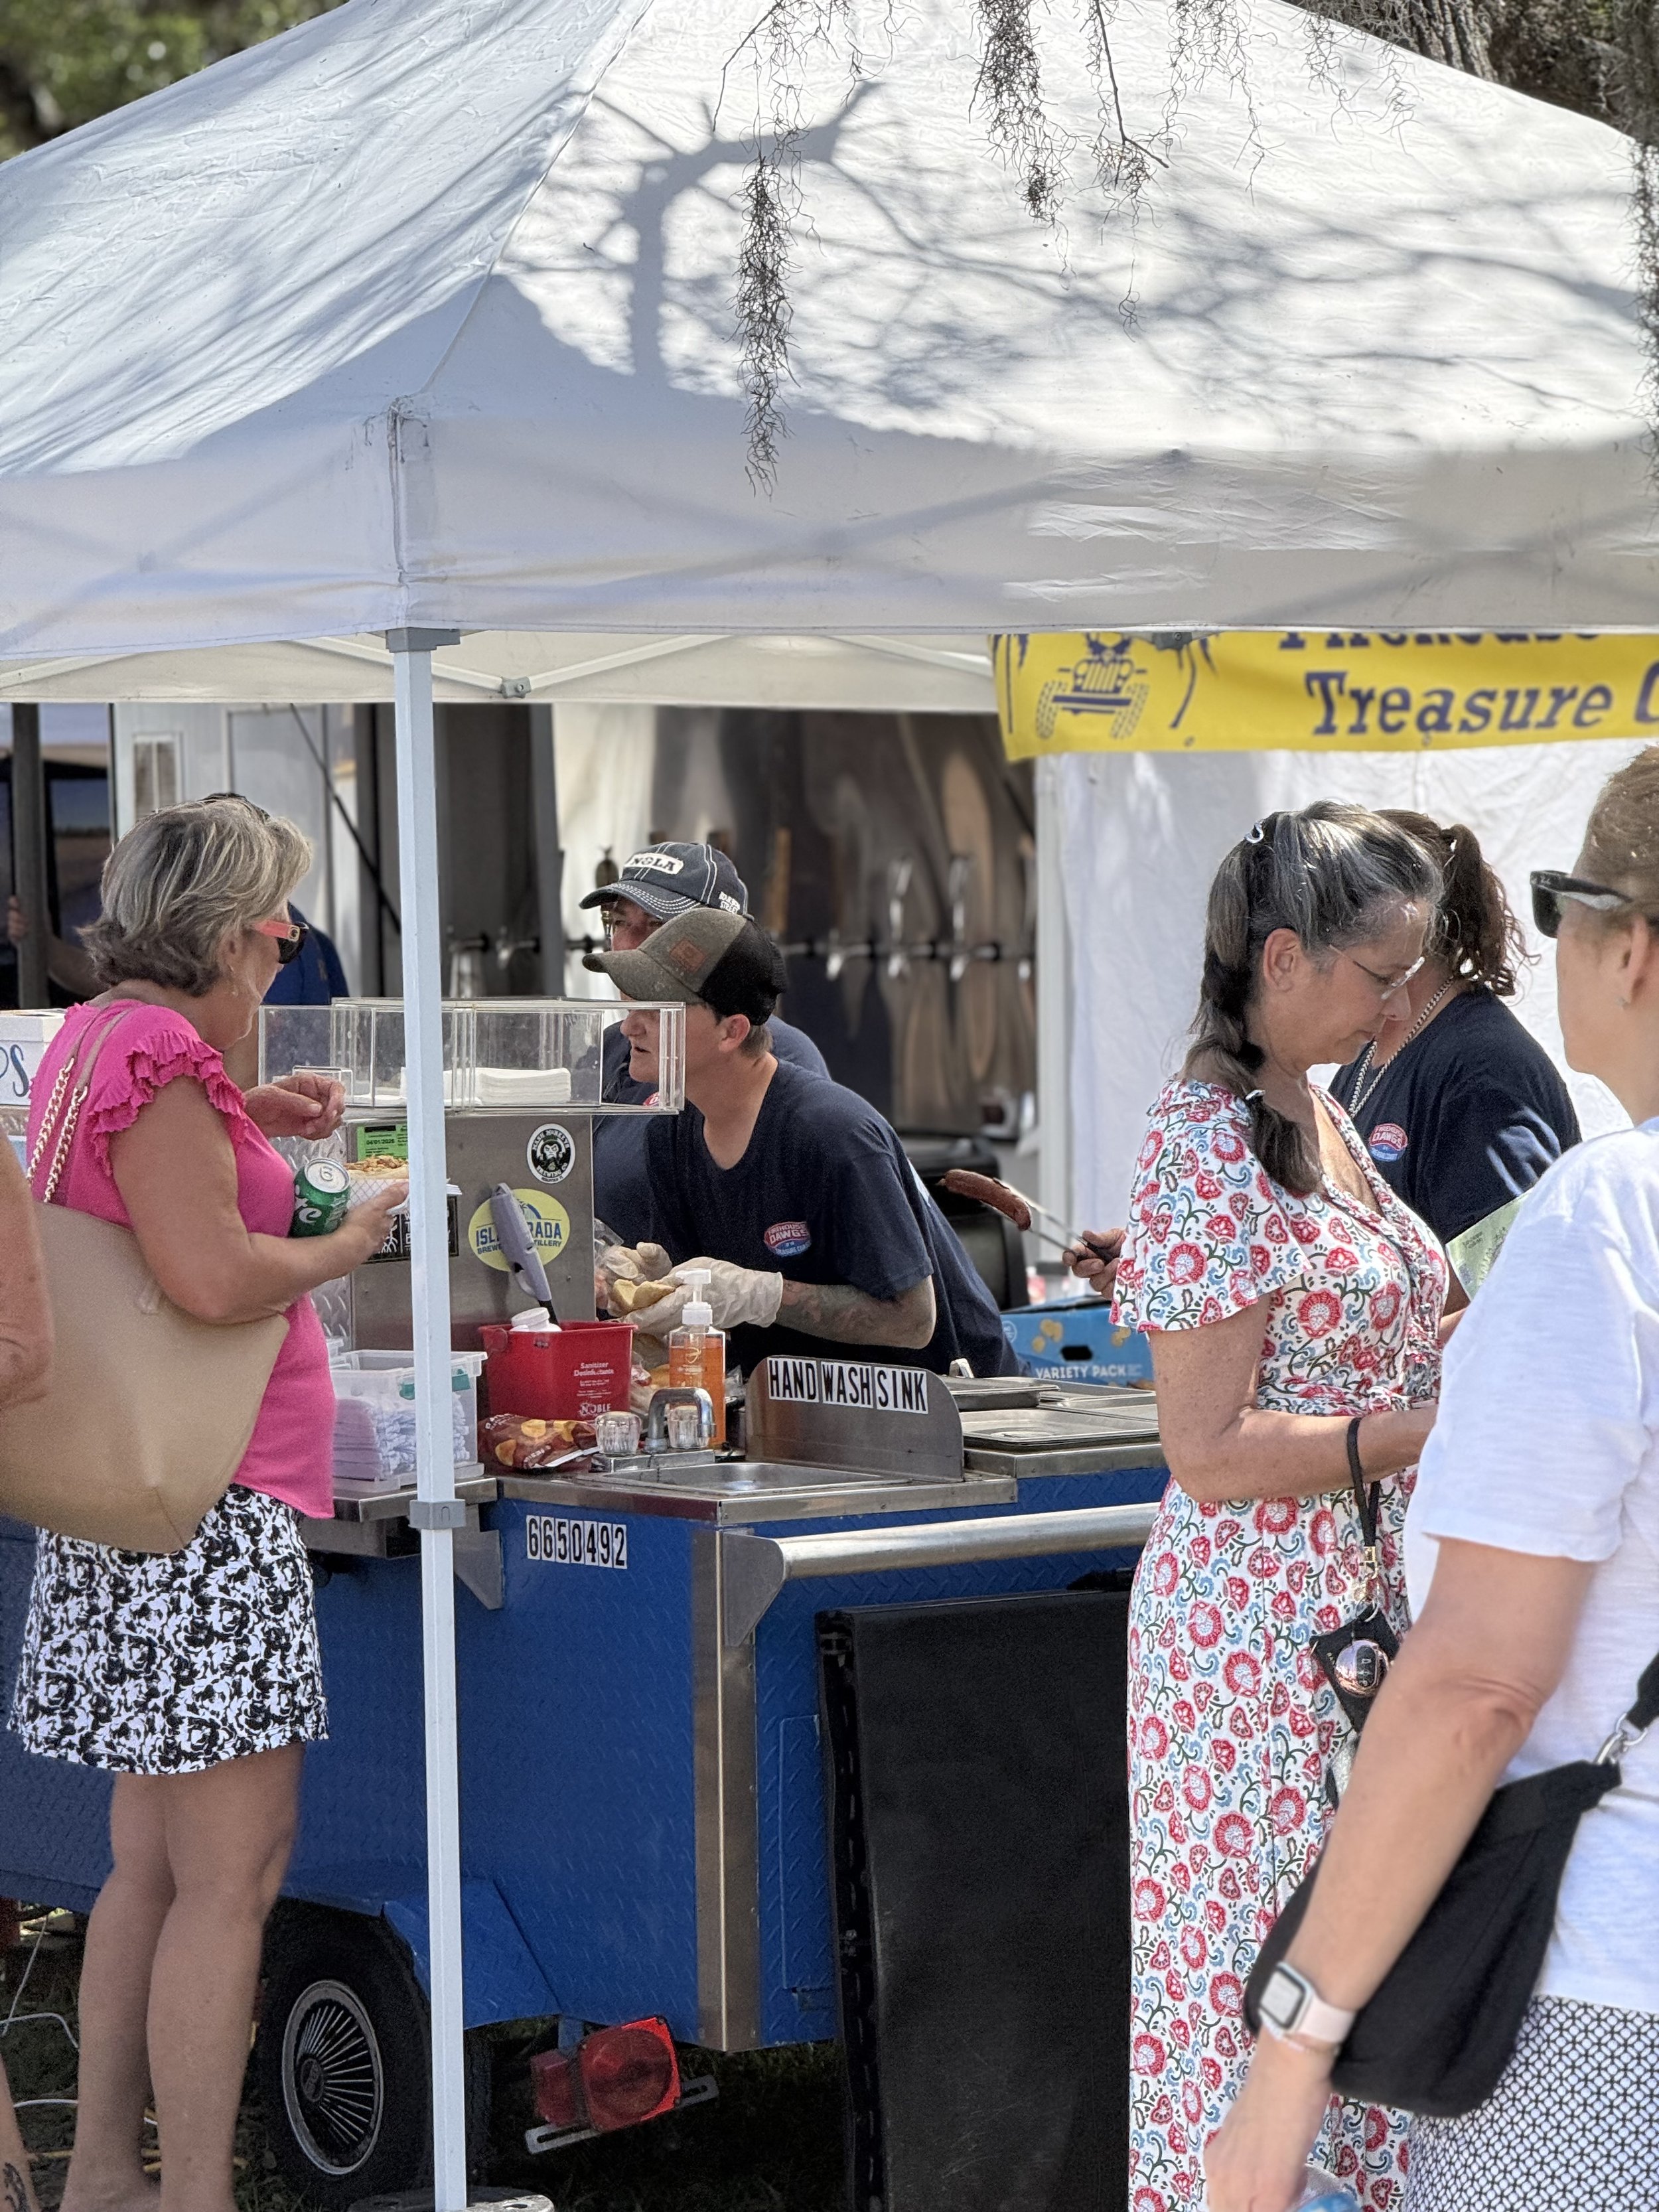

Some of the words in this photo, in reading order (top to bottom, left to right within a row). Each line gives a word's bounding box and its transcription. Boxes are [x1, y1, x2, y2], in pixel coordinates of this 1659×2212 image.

[1305, 672, 1613, 735] Treasure
[630, 857, 676, 871] NOLA
[1372, 1132, 1402, 1149] DAWGS
[476, 1221, 563, 1247] ISLRADA
[770, 1229, 808, 1245] DAWGS
[1035, 1365, 1089, 1379] VARIETY
[1093, 1364, 1127, 1377] PACK
[768, 1360, 817, 1400] HAND
[822, 1364, 872, 1405] WASH
[877, 1370, 927, 1412] SINK
[528, 1517, 625, 1566] 6650492
